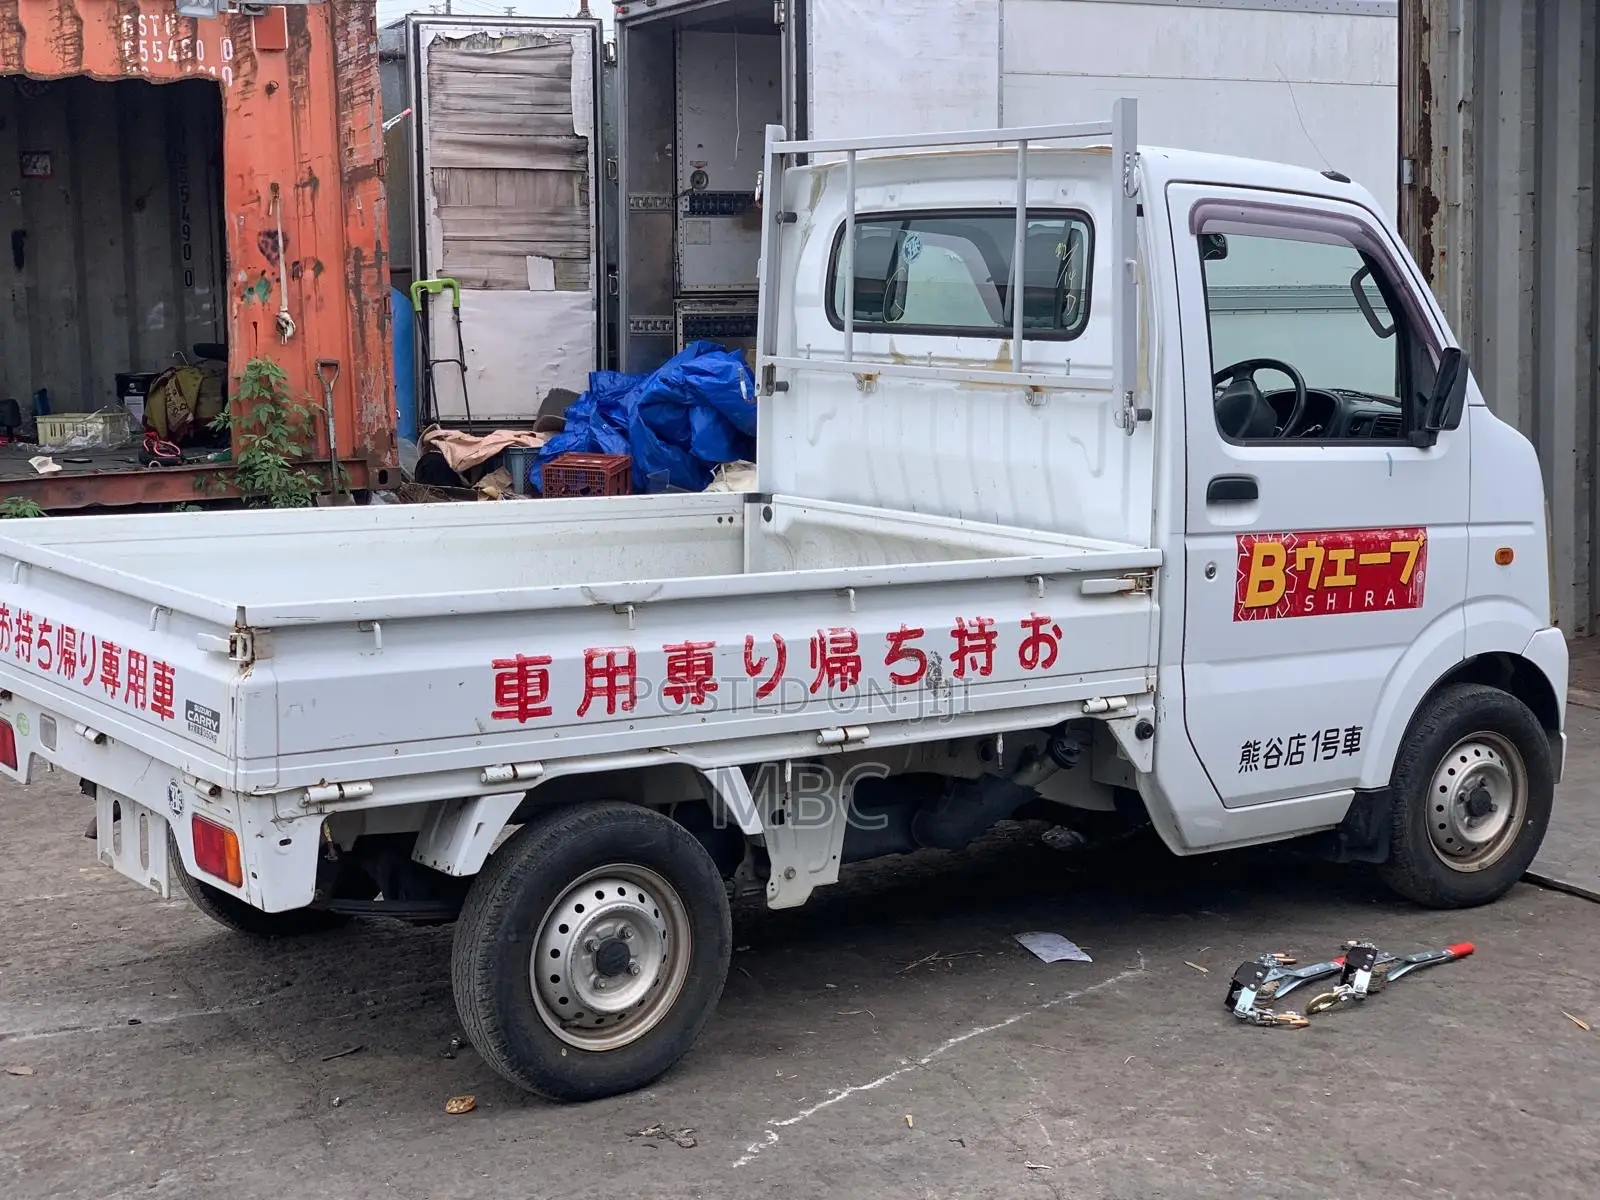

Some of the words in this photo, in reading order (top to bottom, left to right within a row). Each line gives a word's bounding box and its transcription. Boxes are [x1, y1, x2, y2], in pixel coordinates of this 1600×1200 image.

[1304, 588, 1412, 612] SHIRAI
[187, 709, 218, 731] CARRY
[1238, 725, 1363, 774] 熊谷店1号車
